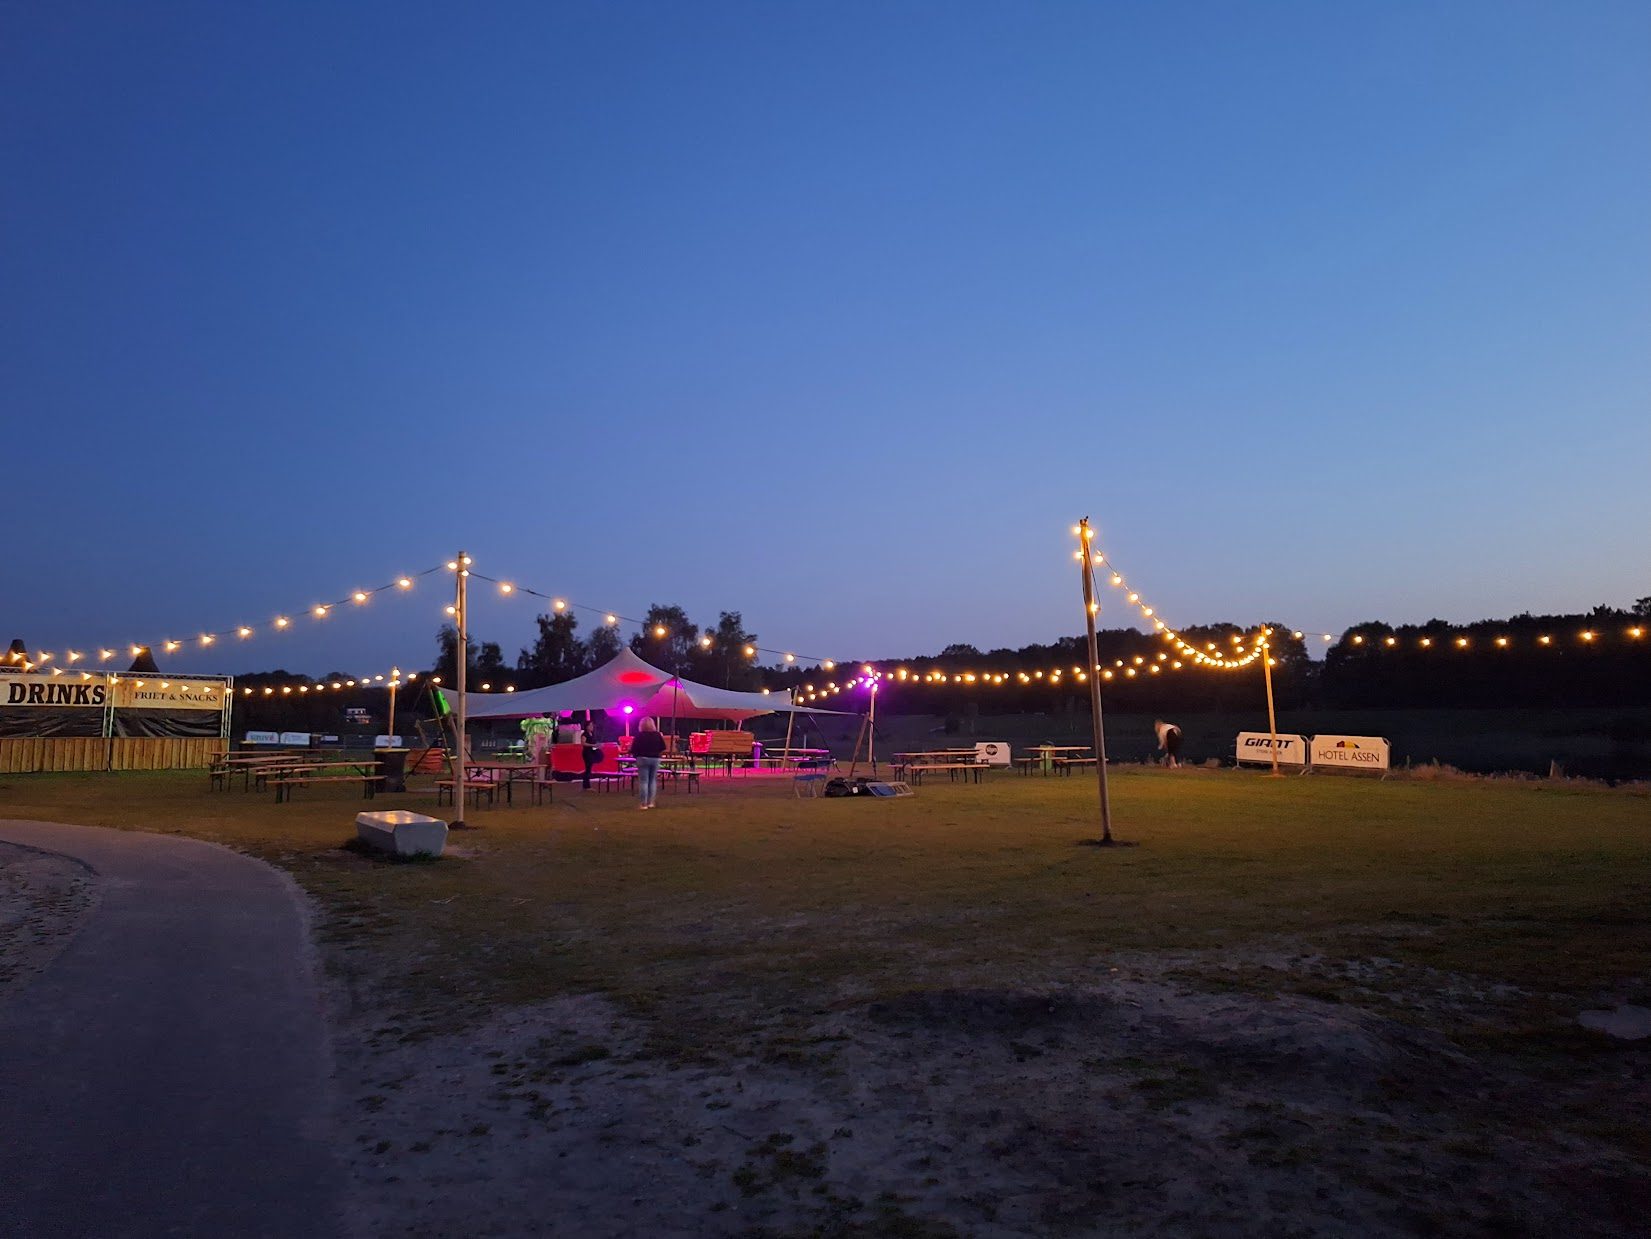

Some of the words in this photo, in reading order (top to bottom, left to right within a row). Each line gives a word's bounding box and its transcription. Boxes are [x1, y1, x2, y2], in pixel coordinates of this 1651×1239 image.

[8, 683, 105, 704] DRINKS
[135, 691, 165, 699] FRIET
[179, 694, 218, 702] SNACKS
[1245, 738, 1293, 748] GIANT
[1318, 750, 1348, 760] HOTEL
[1351, 752, 1380, 762] ASSEN
